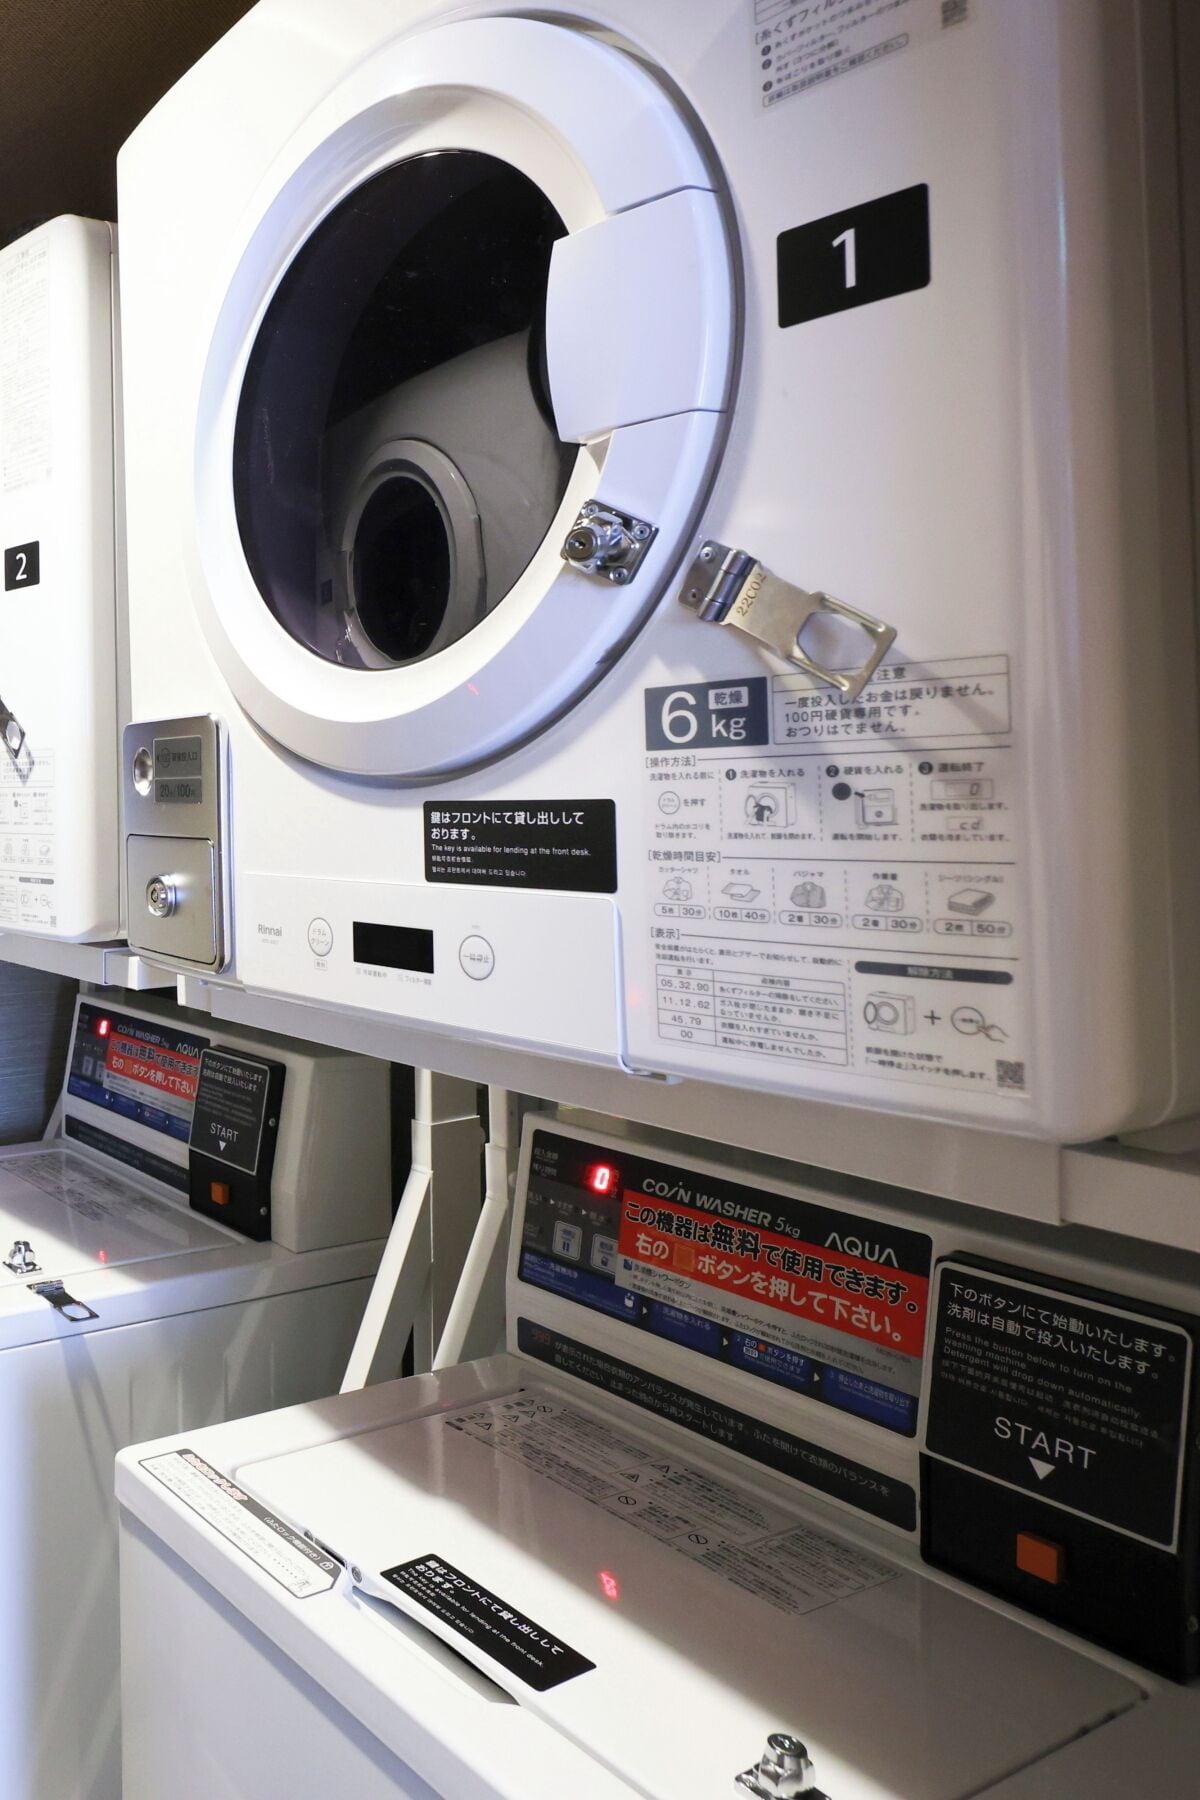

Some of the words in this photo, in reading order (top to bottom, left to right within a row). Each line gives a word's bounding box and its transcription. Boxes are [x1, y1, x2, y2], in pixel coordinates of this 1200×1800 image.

[833, 228, 856, 289] 1
[16, 552, 27, 581] 2
[714, 690, 743, 706] 乾燥
[784, 683, 994, 707] 一度投入したお金は戻りません。
[661, 691, 698, 744] 6
[711, 714, 746, 740] kg
[785, 704, 920, 723] 100円硬貨専用です。
[431, 812, 584, 825] 鍵はフロントにて貸し出しして
[431, 828, 476, 841] おります。
[444, 845, 455, 853] key
[503, 846, 529, 856] lending
[552, 848, 569, 856] front
[257, 923, 282, 937] Rinnai
[176, 1042, 199, 1058] AQUA
[210, 1122, 239, 1142] START
[594, 1167, 610, 1190] 0
[696, 1195, 772, 1228] WASHER
[775, 1216, 801, 1239] 5kg
[625, 1202, 919, 1314] この機器は無料で使用できます。
[825, 1232, 899, 1268] AQUA
[635, 1232, 669, 1260] 右の
[698, 1254, 902, 1342] ボタンを押して下さい。
[950, 1283, 1176, 1363] 下のボタンにて始動いたします。
[944, 1337, 982, 1356] washing
[947, 1302, 1159, 1380] 洗剤は自動で投入いたします。
[944, 1346, 989, 1367] Detergent
[993, 1363, 1008, 1373] will
[1012, 1370, 1034, 1382] drop
[1037, 1378, 1064, 1391] down
[945, 1326, 972, 1342] Press
[975, 1336, 990, 1347] the
[993, 1342, 1023, 1357] button
[1027, 1352, 1056, 1368] below
[1060, 1364, 1069, 1373] to
[1074, 1368, 1093, 1380] turn
[1098, 1377, 1111, 1386] on
[1115, 1381, 1132, 1393] the
[994, 1416, 1096, 1469] START
[415, 1563, 455, 1594] おります。
